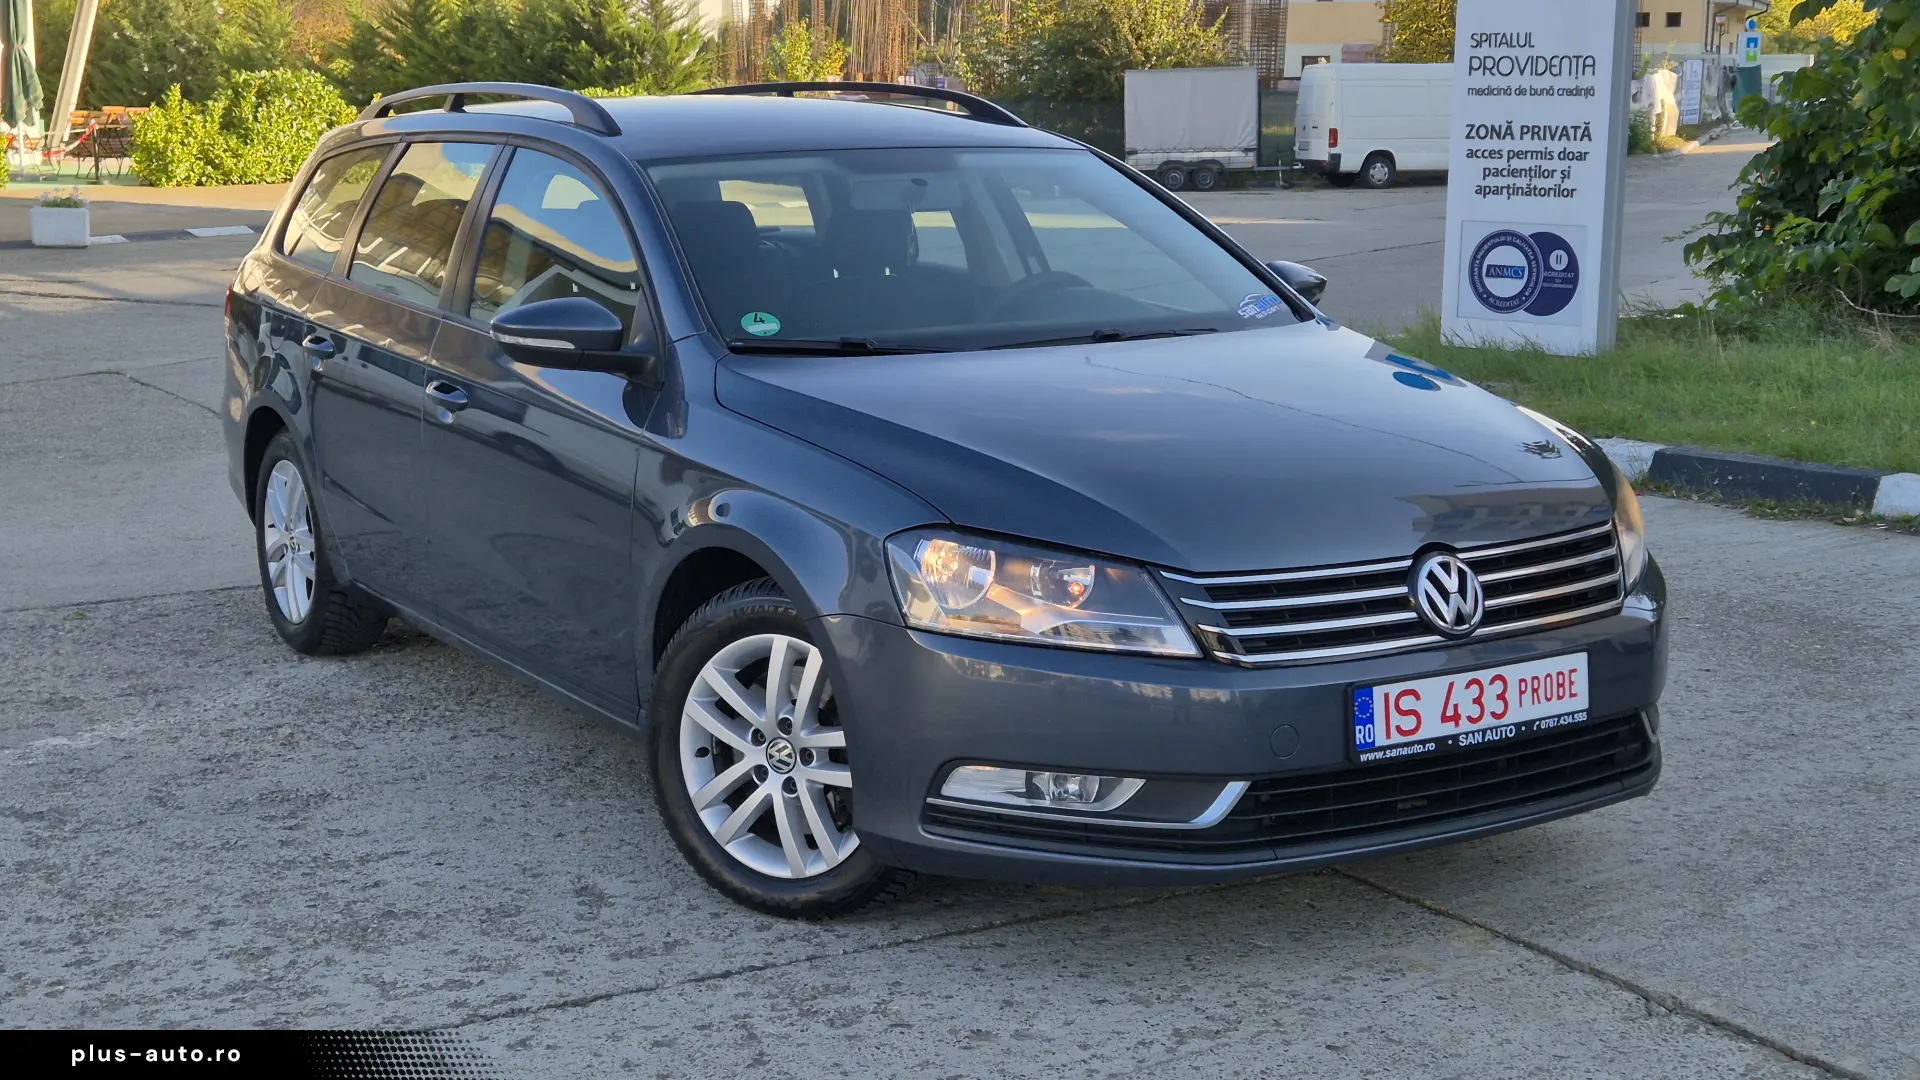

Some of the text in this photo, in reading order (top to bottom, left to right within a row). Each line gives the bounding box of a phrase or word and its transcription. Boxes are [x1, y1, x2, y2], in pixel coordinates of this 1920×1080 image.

[1470, 32, 1535, 48] SPITALUL
[1468, 55, 1596, 80] PROVIDENȚA
[1468, 85, 1595, 99] medicină de bună credință
[1465, 120, 1592, 142] ZONĂ PRIVATĂ
[1466, 147, 1589, 163] acces permis doar
[1482, 164, 1571, 184] pacienților și
[1474, 183, 1577, 200] aparținătorilor
[1488, 266, 1523, 278] ANMCS
[1488, 296, 1521, 308] ACREDITAT
[753, 313, 765, 324] 4
[732, 604, 797, 617] WINTE
[1383, 668, 1578, 740] IS 433 PROBE
[1355, 724, 1374, 745] RO
[1359, 712, 1588, 762] www.sanauto.ro SAN AUTO 0787.434.555
